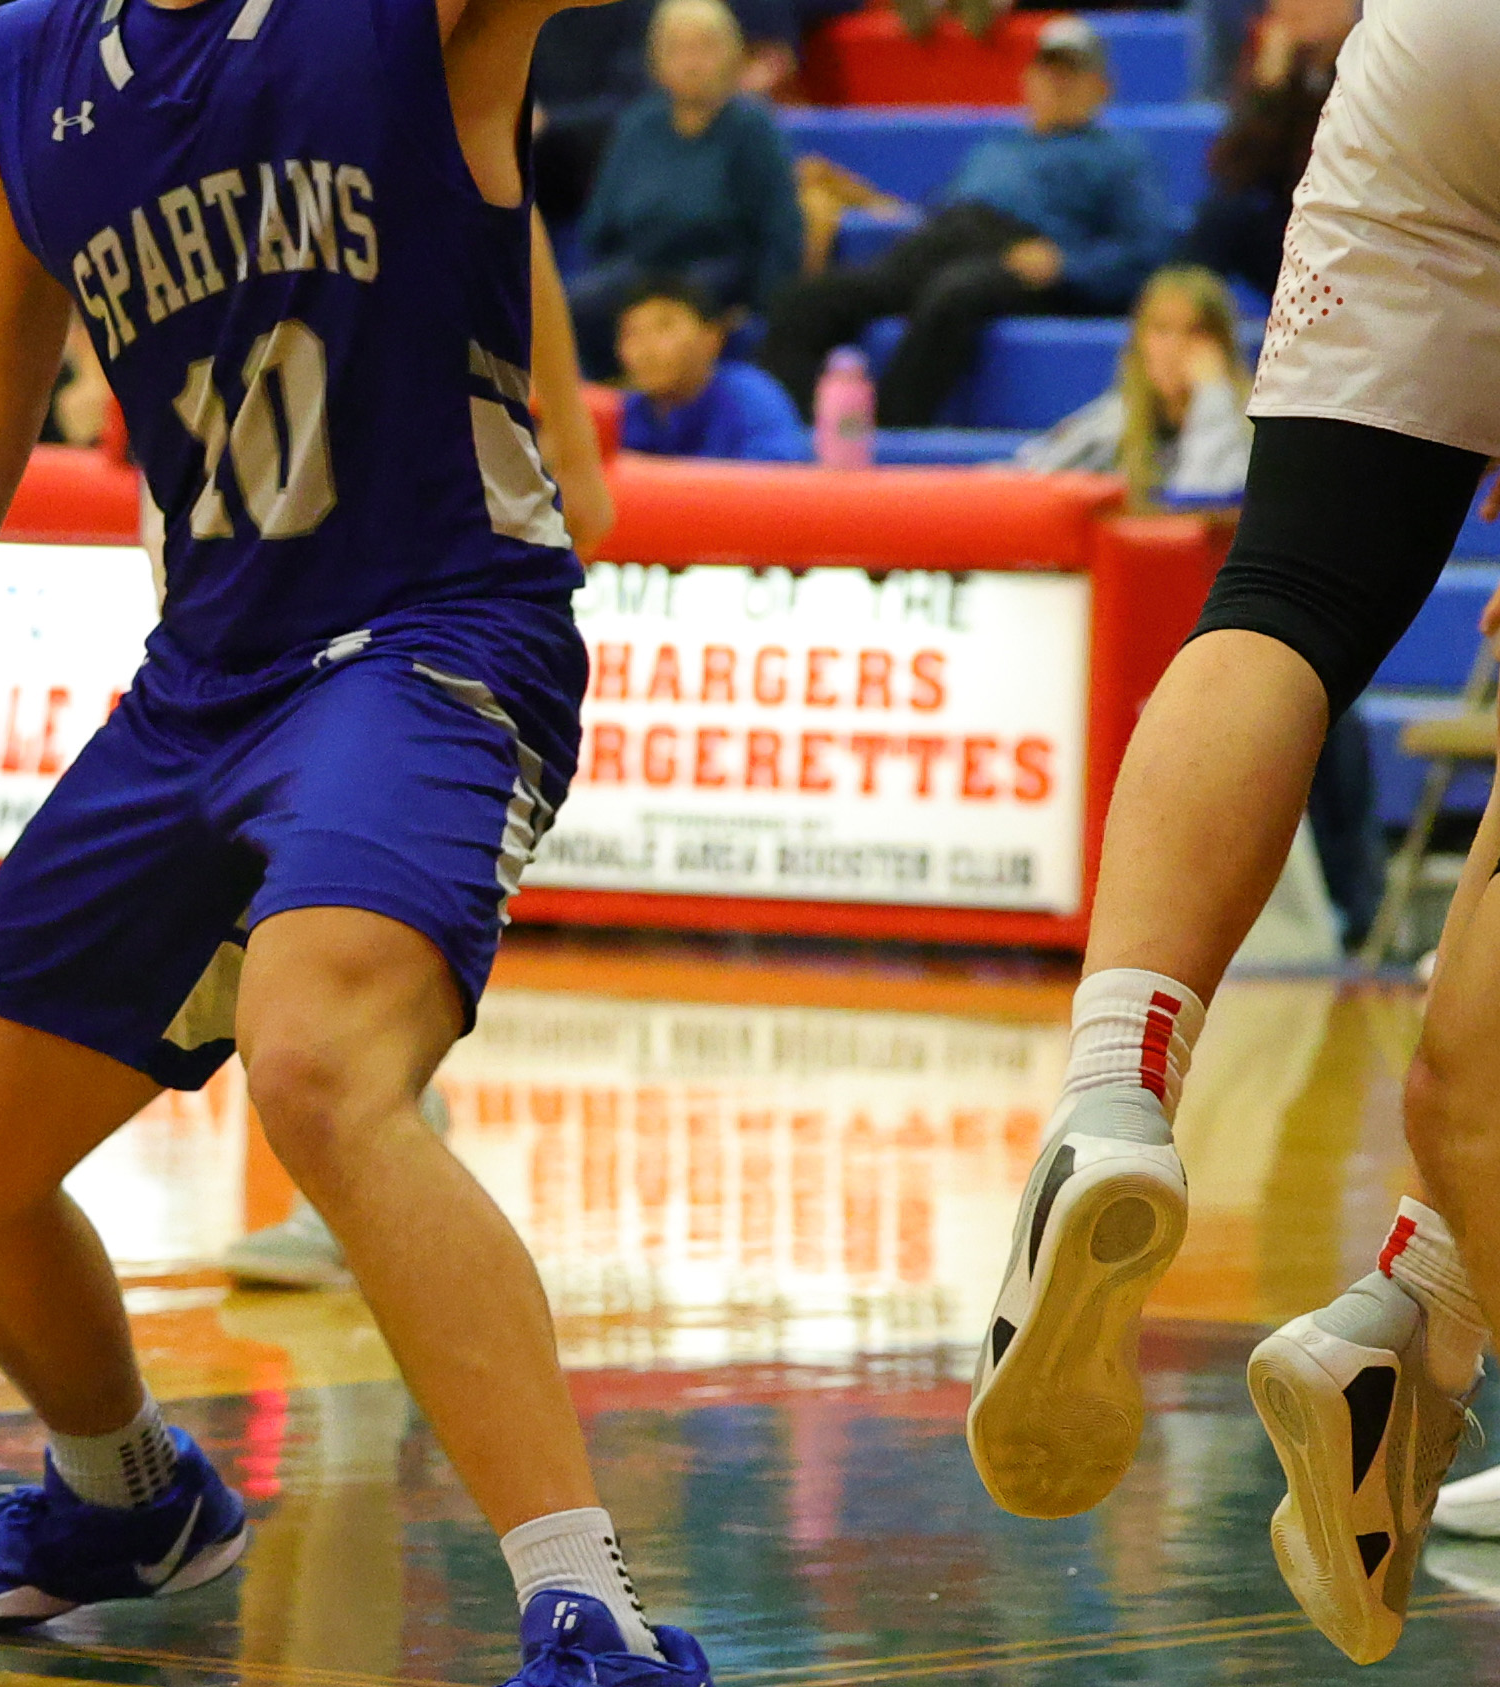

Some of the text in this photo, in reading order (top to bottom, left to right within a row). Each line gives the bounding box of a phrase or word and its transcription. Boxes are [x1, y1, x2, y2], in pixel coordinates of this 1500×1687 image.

[71, 160, 380, 362] SPARTANS
[172, 318, 338, 540] 10
[590, 640, 950, 714] HARGERS
[578, 722, 1056, 802] RGERETTES
